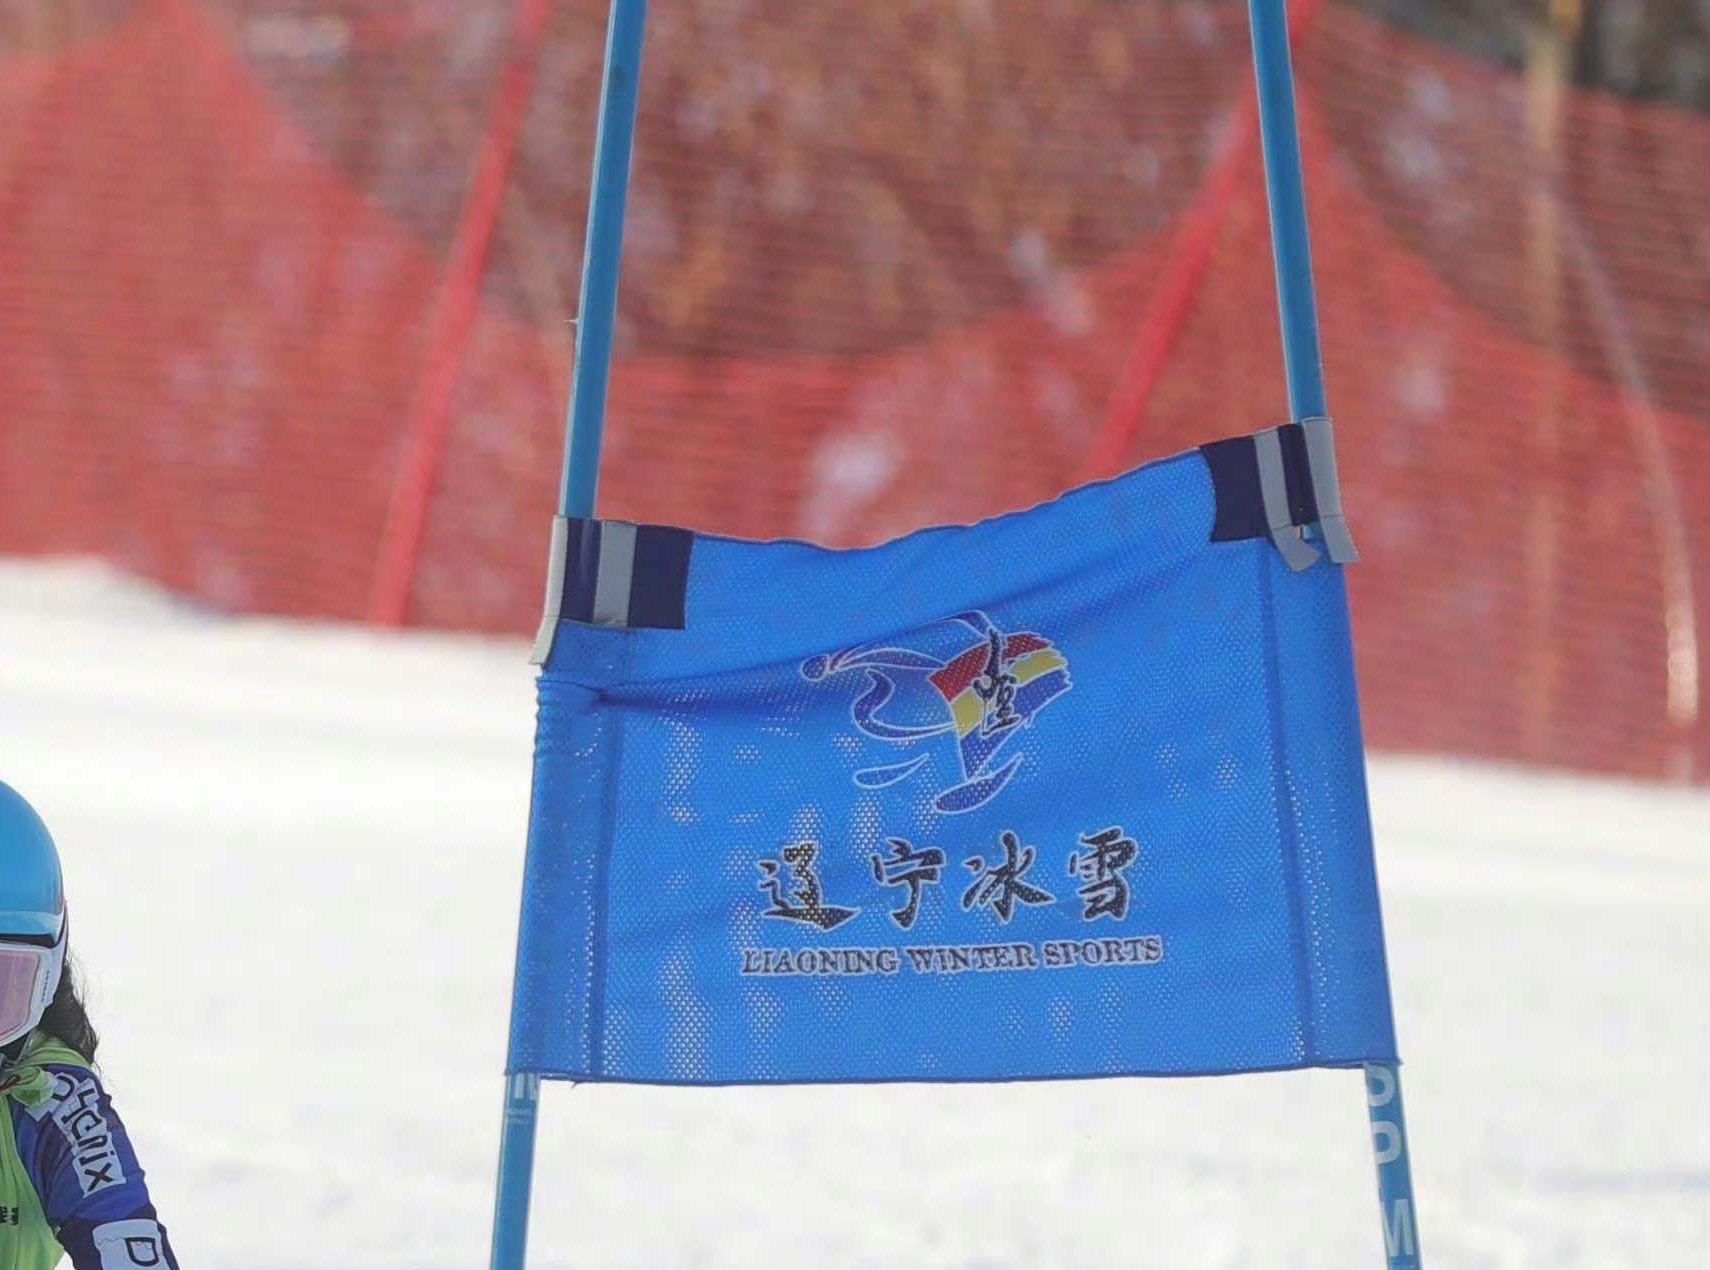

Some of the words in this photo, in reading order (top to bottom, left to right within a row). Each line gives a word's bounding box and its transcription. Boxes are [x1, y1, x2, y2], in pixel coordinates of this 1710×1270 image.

[741, 947, 900, 976] LIAONING
[907, 942, 1037, 973] WINTER
[1043, 935, 1163, 967] SPORTS
